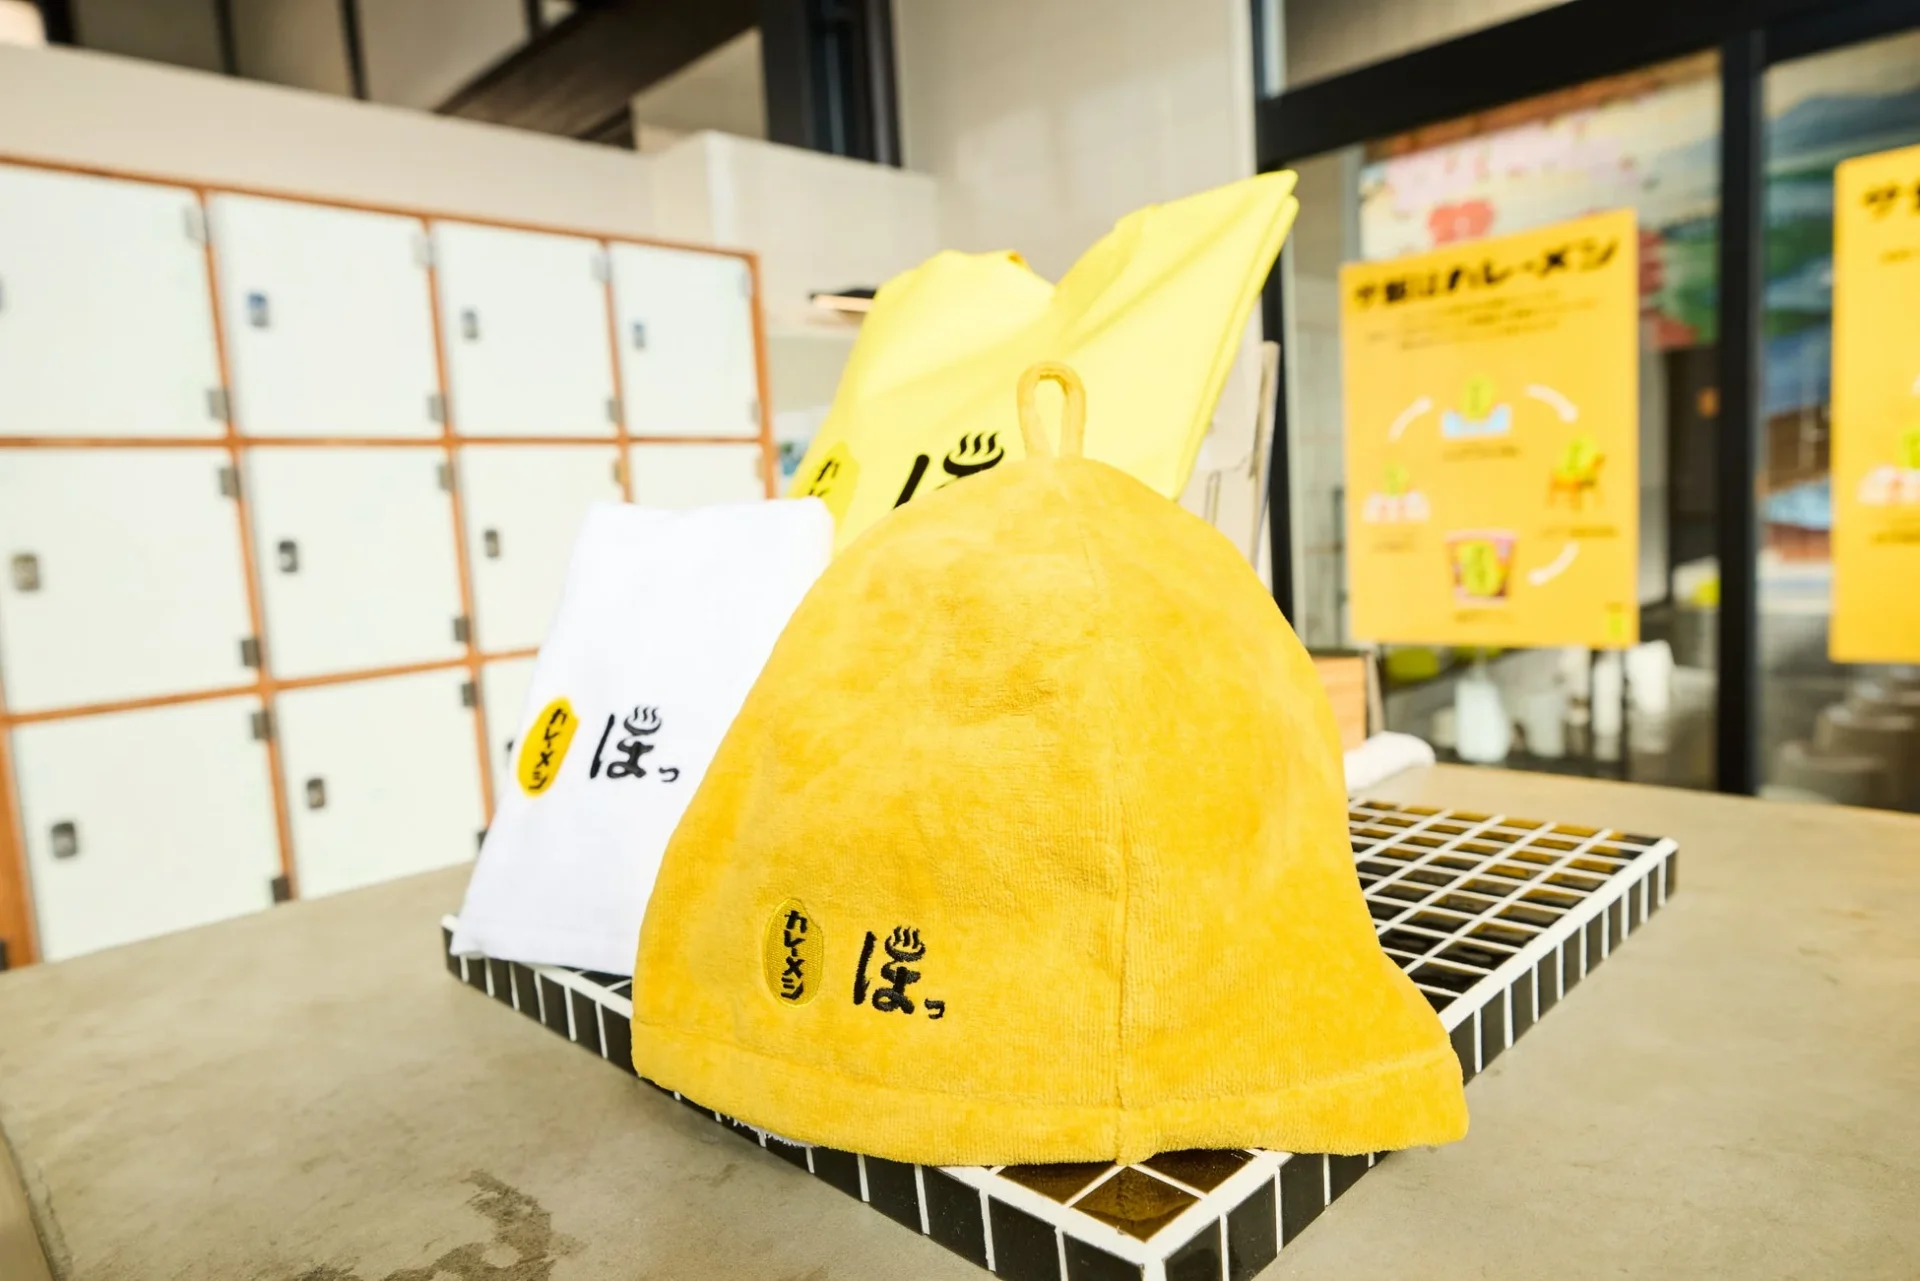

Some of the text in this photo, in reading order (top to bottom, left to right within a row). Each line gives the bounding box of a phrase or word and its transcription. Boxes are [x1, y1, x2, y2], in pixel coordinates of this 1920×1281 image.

[528, 707, 568, 791] カレーメシ
[780, 909, 808, 1001] カレーメシ
